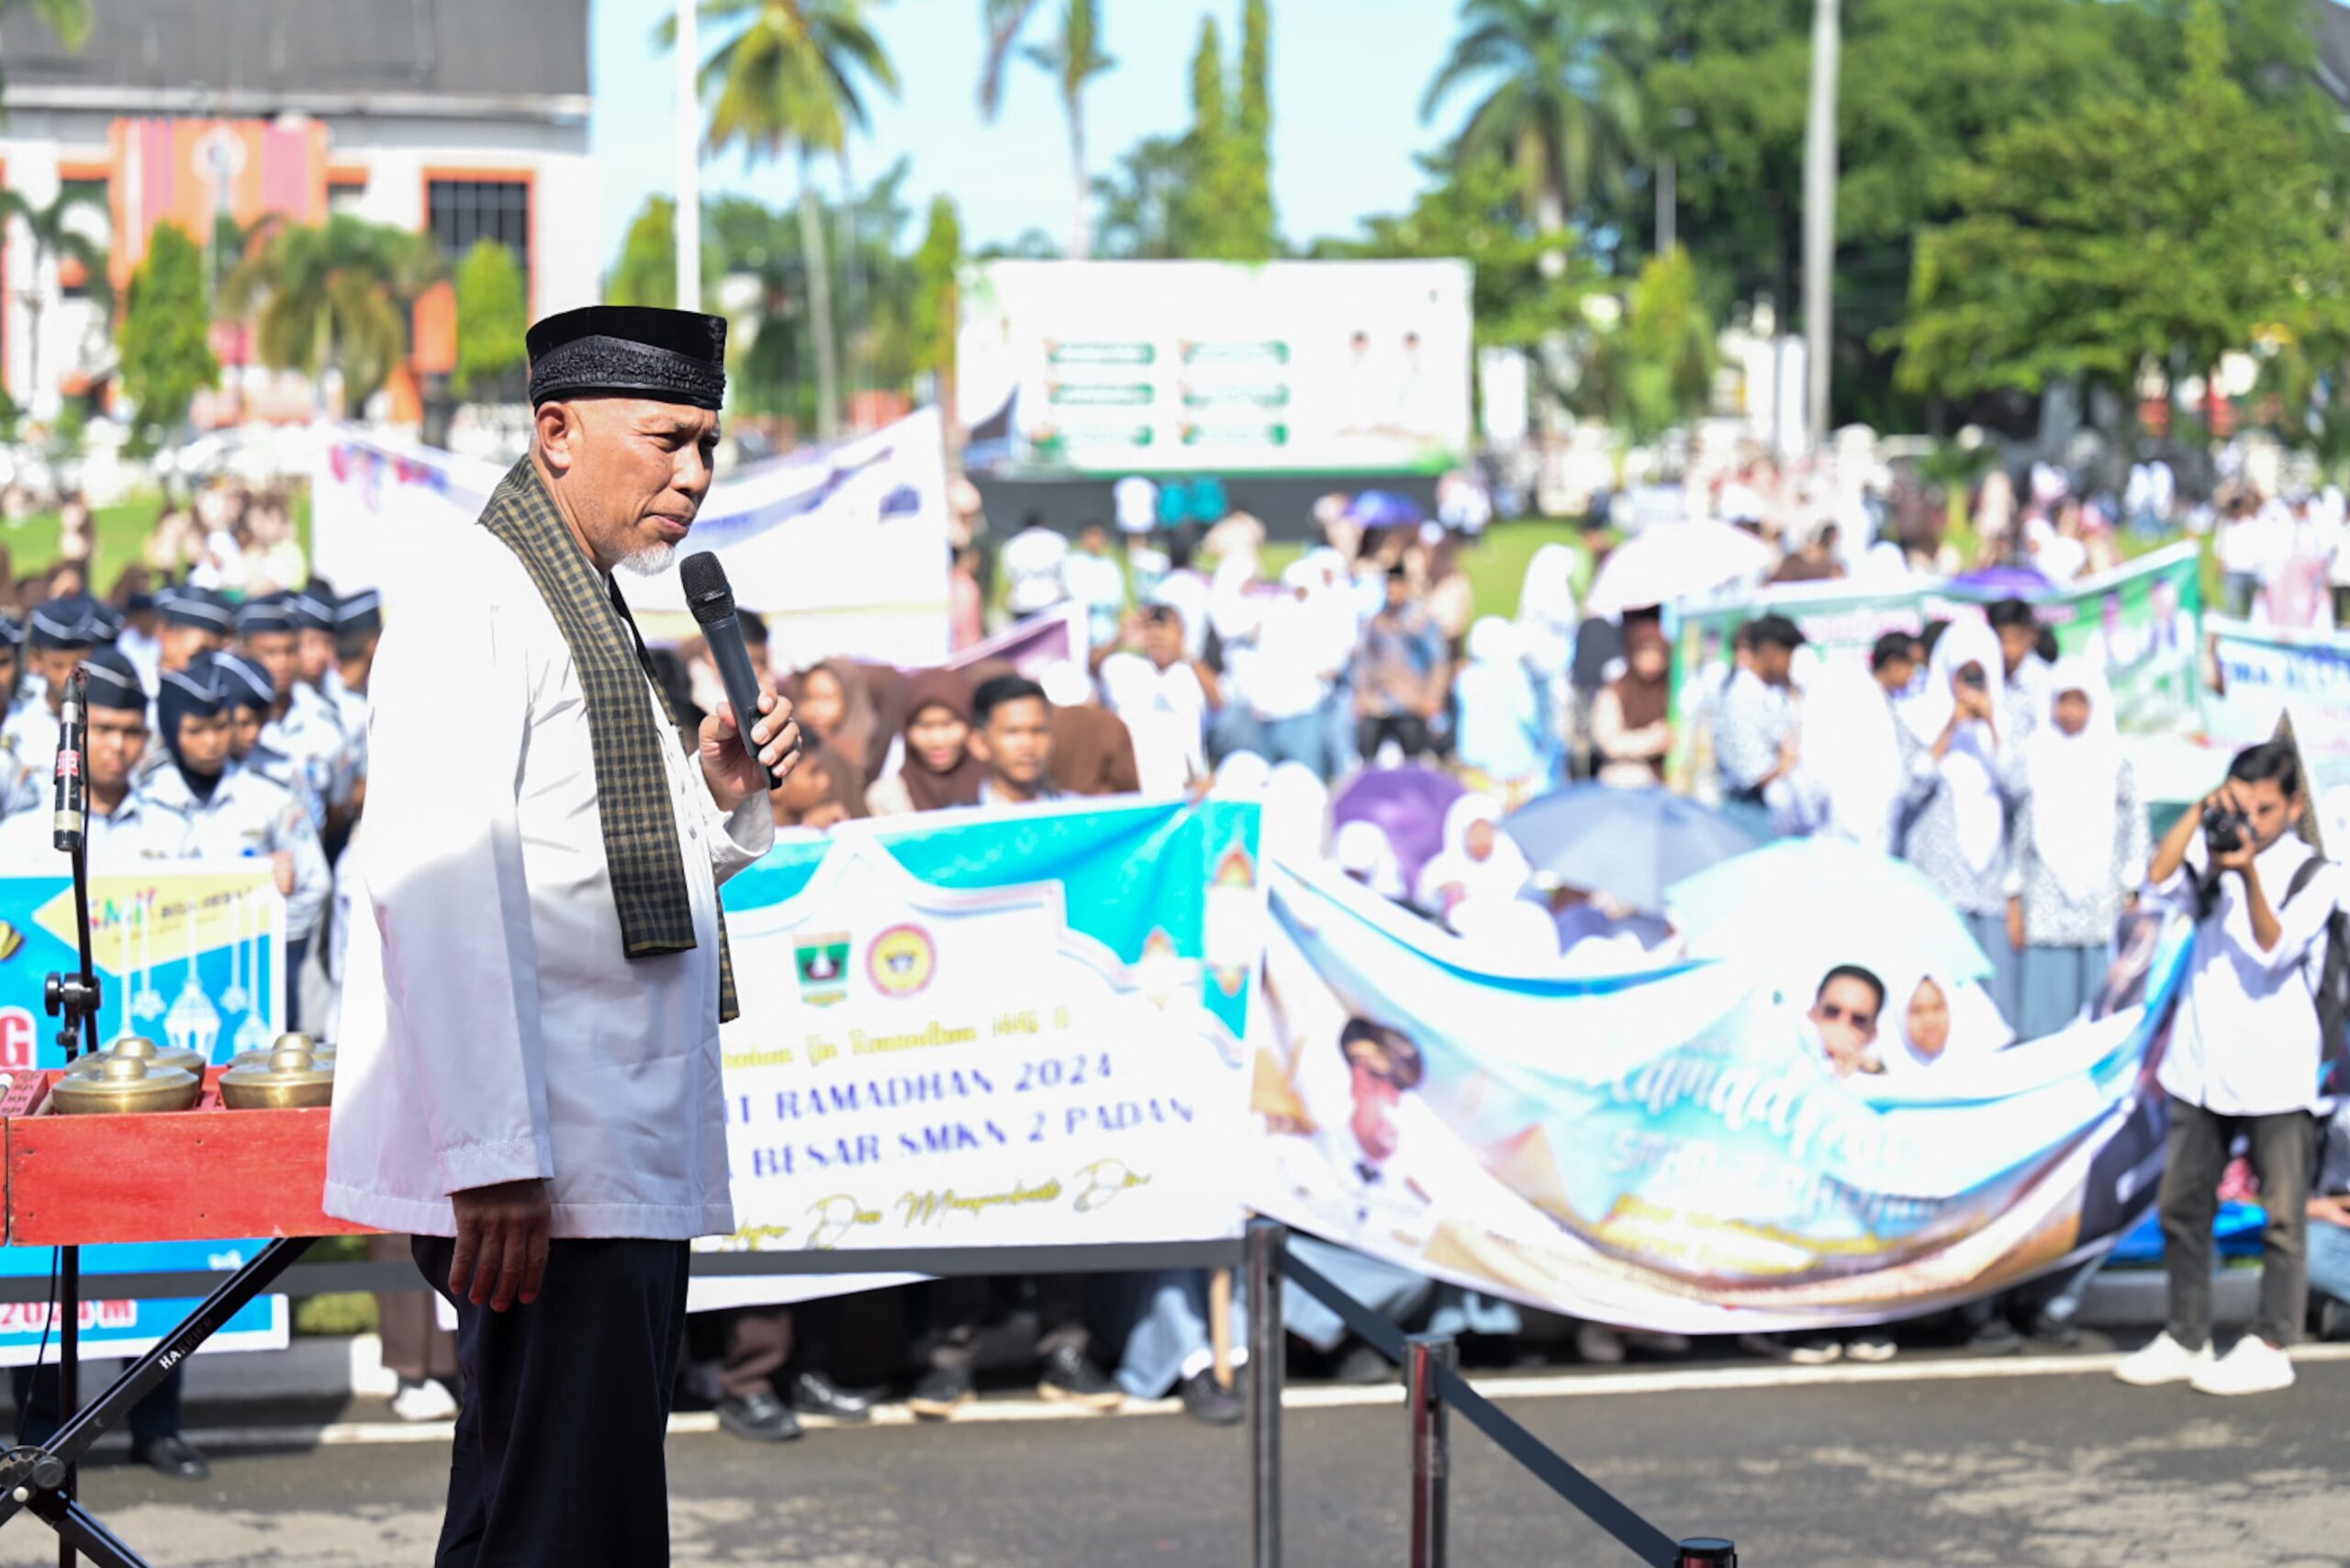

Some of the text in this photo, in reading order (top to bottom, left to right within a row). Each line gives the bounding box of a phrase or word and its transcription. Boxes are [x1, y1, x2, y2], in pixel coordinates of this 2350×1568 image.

[776, 1068, 994, 1122] RAMADHAN
[1014, 1051, 1113, 1092] 2024
[752, 1133, 880, 1179] BESAR
[1027, 1111, 1046, 1143] 2
